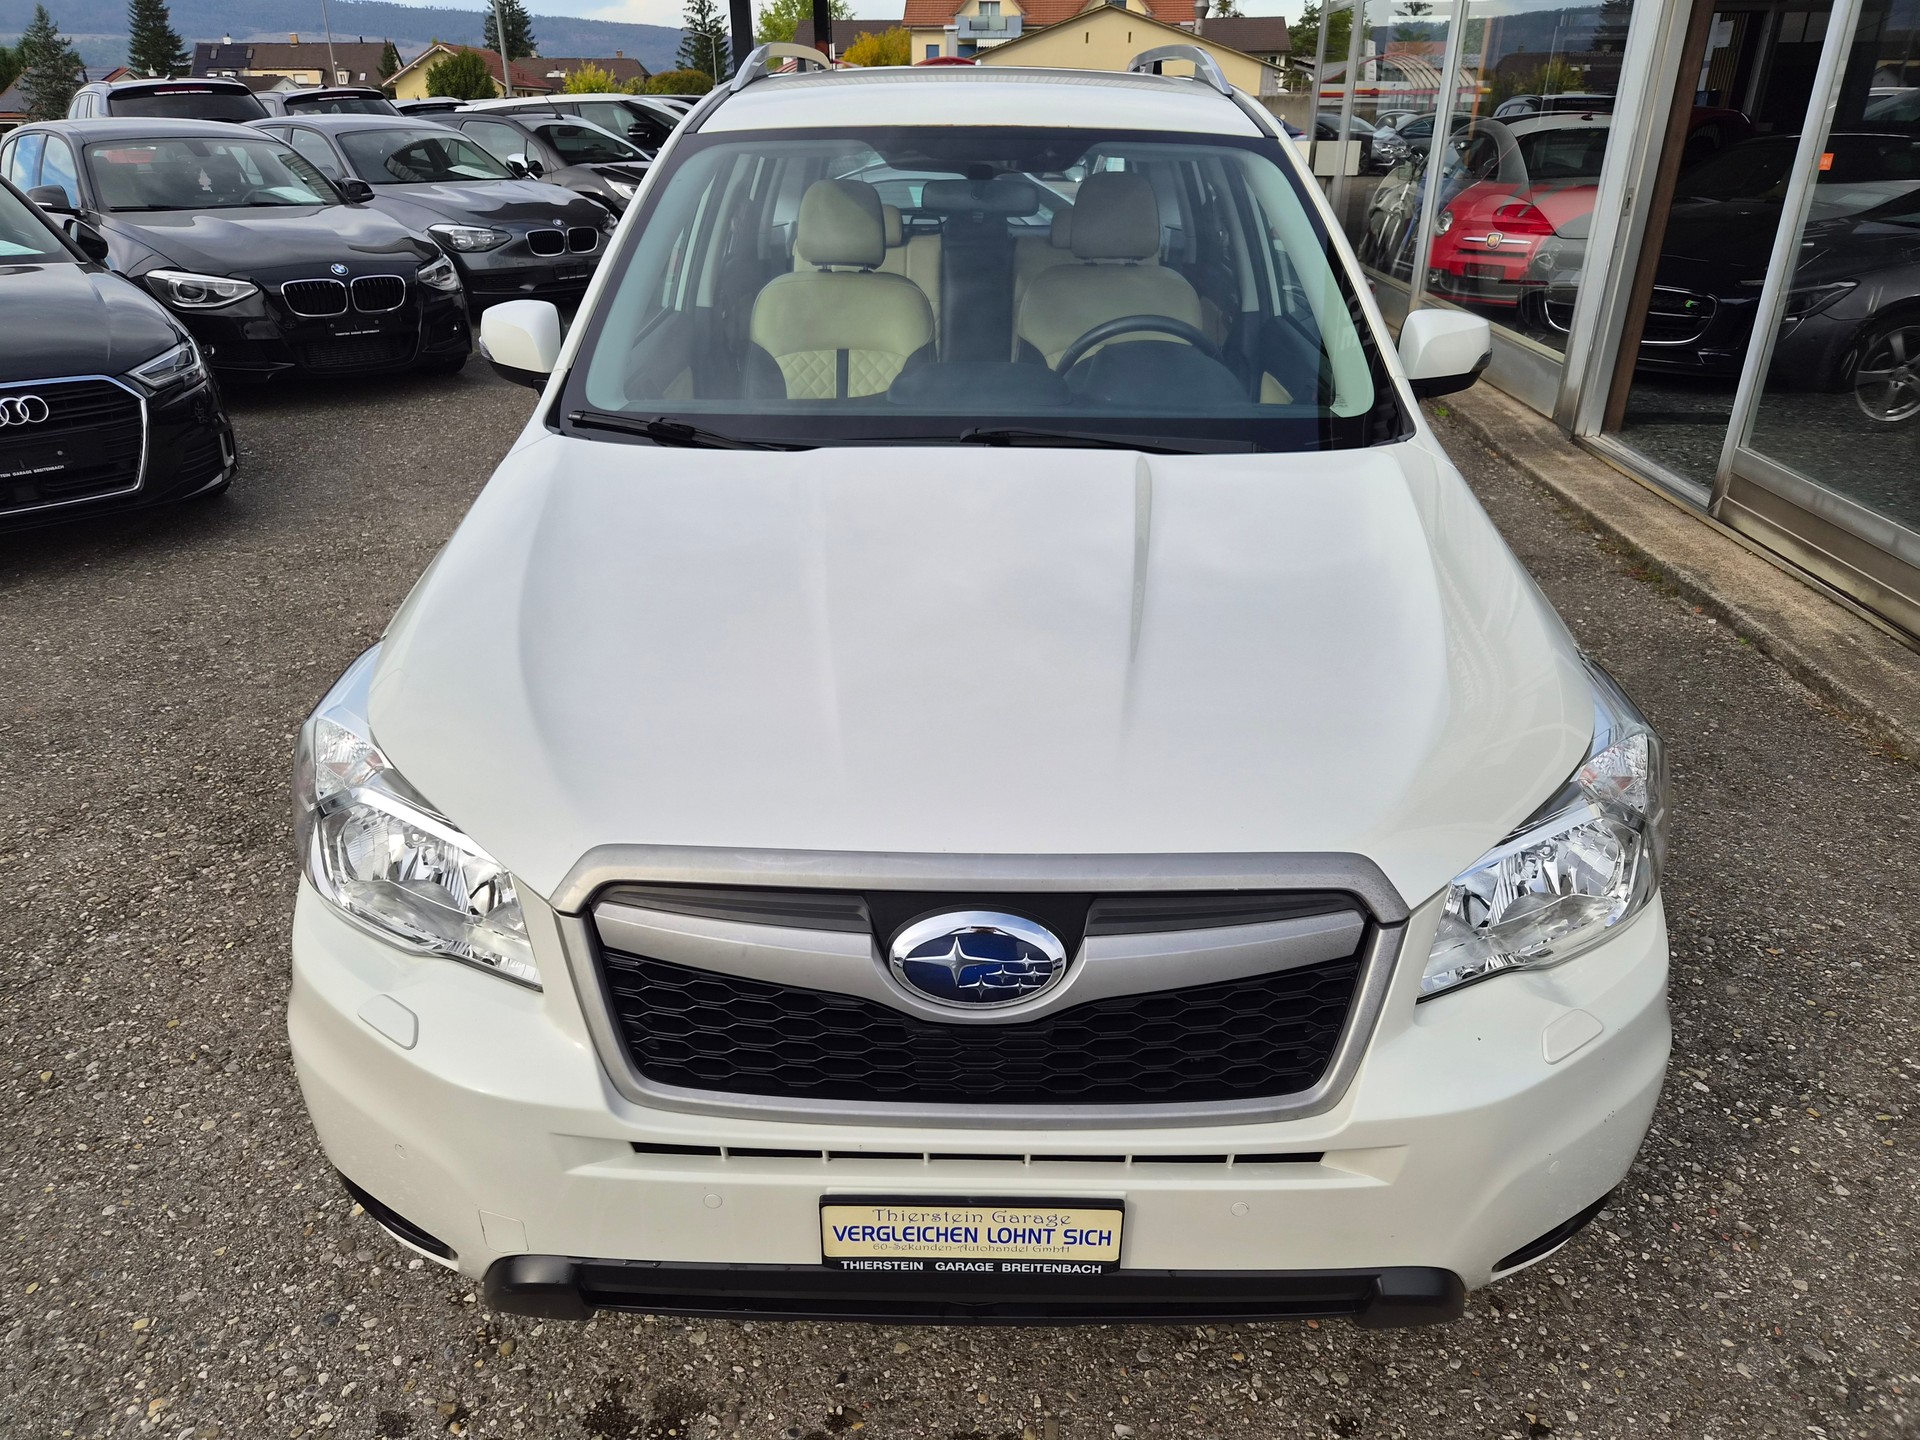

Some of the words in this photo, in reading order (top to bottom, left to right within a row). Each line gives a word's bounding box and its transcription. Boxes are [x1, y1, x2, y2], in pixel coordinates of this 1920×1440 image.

[872, 1208, 983, 1224] Thierstein
[992, 1210, 1072, 1227] Garage
[832, 1225, 978, 1244] VERGLEICHEN
[987, 1227, 1056, 1245] LOHNT
[1063, 1229, 1112, 1246] SICH
[1032, 1245, 1070, 1253] GmbH
[841, 1260, 924, 1271] THIERSTEIN
[935, 1261, 995, 1272] GARAGE
[1001, 1263, 1102, 1274] BREITENBACH
